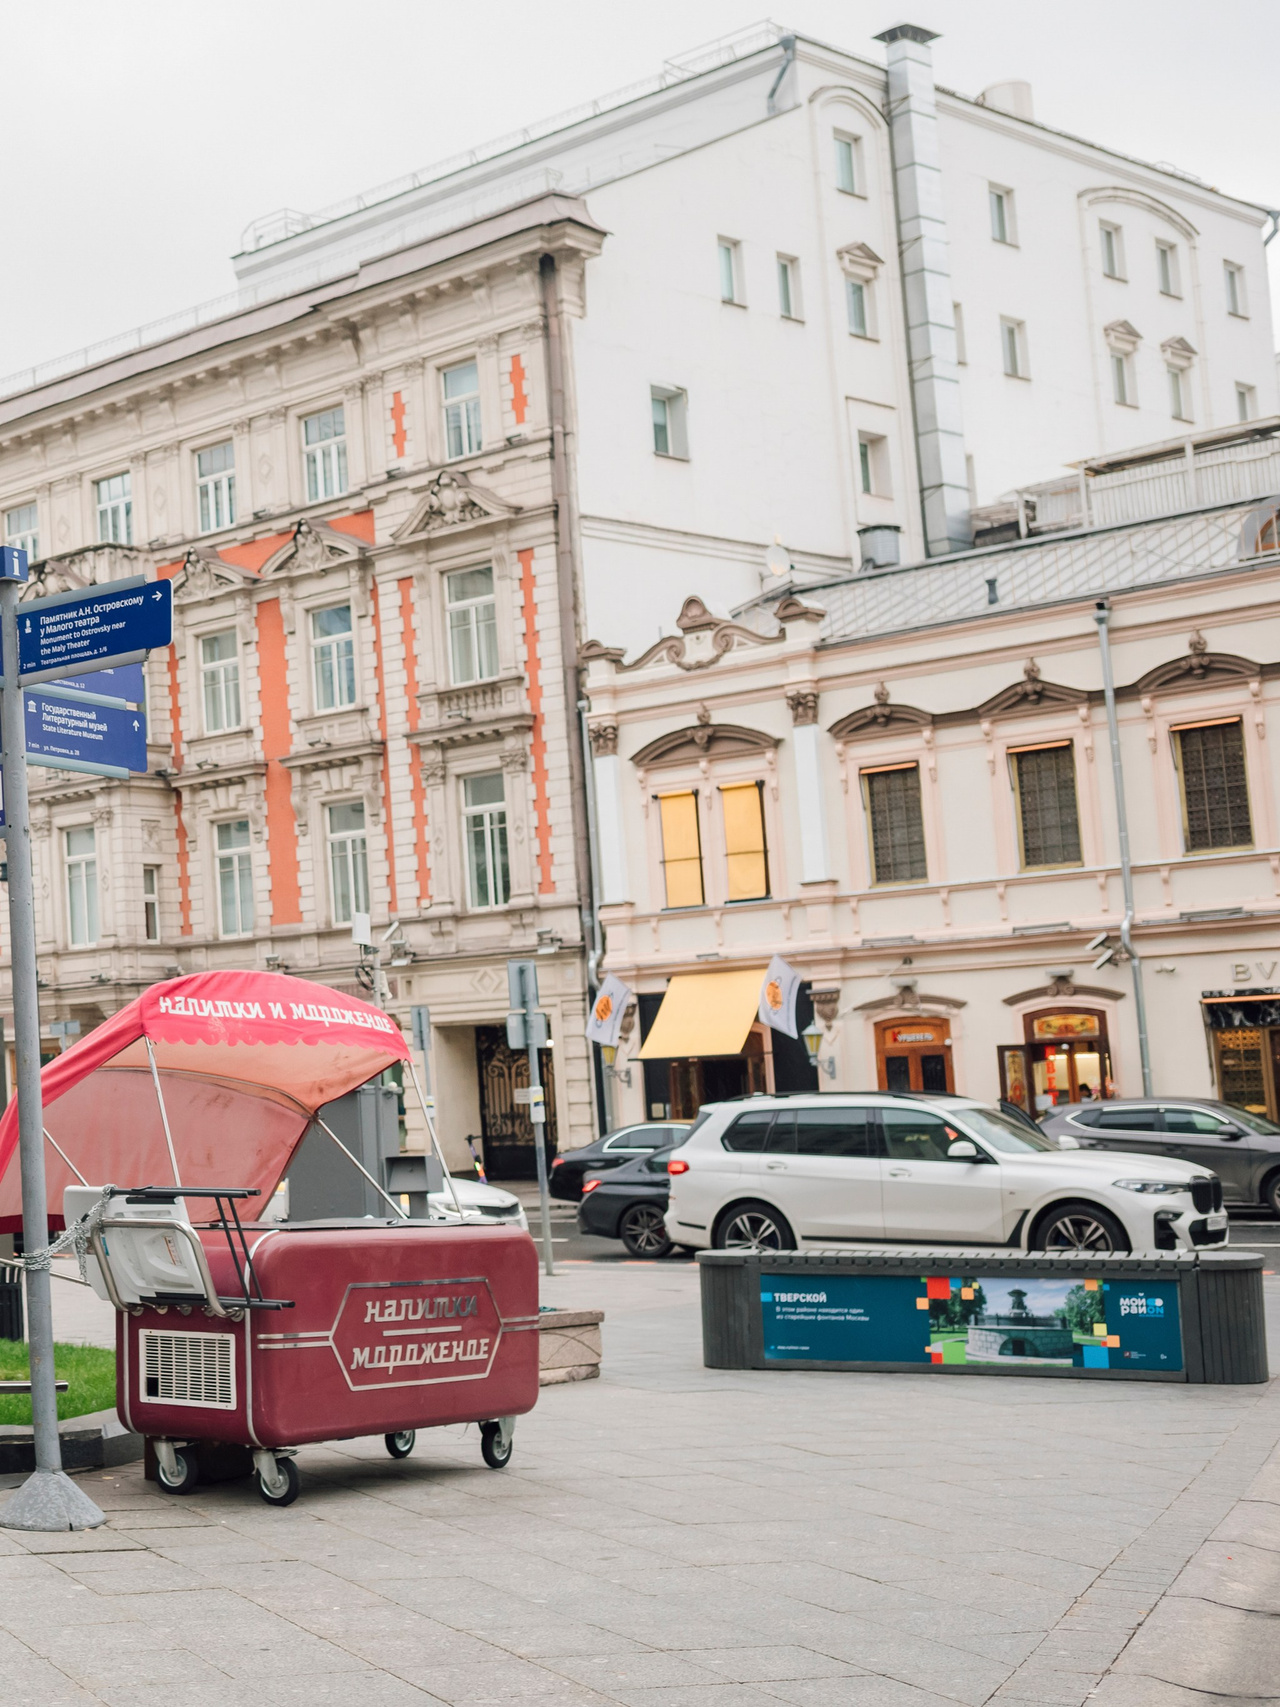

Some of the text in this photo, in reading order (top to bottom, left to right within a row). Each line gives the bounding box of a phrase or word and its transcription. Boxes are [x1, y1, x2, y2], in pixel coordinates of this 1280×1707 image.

[40, 595, 144, 625] Памятник А.Н. Островскому
[40, 616, 100, 637] у Малого театра
[40, 634, 73, 645] Monument
[81, 625, 111, 637] Ostrovsky
[40, 639, 90, 656] the Maly Theater
[41, 655, 70, 666] Театральная
[42, 702, 96, 720] Государственный
[42, 713, 108, 732] Литературный музей
[42, 724, 103, 740] State Literature Museum
[774, 1292, 826, 1302] ТВЕРСКОЙ
